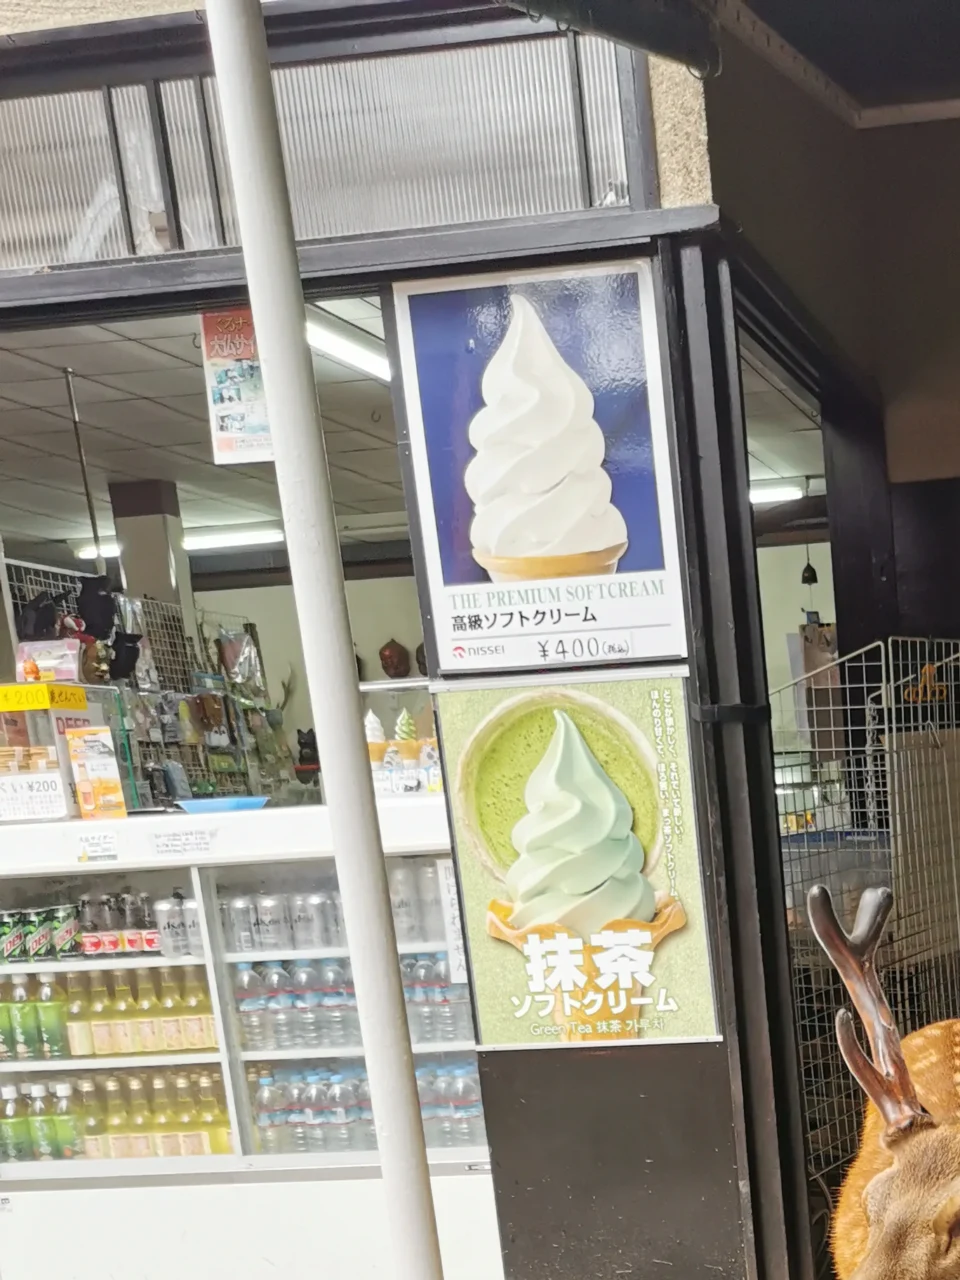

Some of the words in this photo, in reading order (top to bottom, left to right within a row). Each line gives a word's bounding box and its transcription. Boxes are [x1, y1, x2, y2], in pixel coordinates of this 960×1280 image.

[209, 334, 255, 357] 大仏サイ
[449, 591, 483, 610] THE
[487, 586, 562, 608] PREMIUM
[565, 579, 665, 604] SOFTCREAM
[452, 606, 598, 632] 高級ソフトクリーム
[26, 780, 58, 793] ¥200
[522, 929, 656, 993] 抹茶
[510, 988, 680, 1019] ソフトクリーム
[530, 1022, 566, 1036] Green
[570, 1021, 593, 1034] Tea
[596, 1019, 622, 1033] 抹茶
[626, 1017, 665, 1032] 가루차
